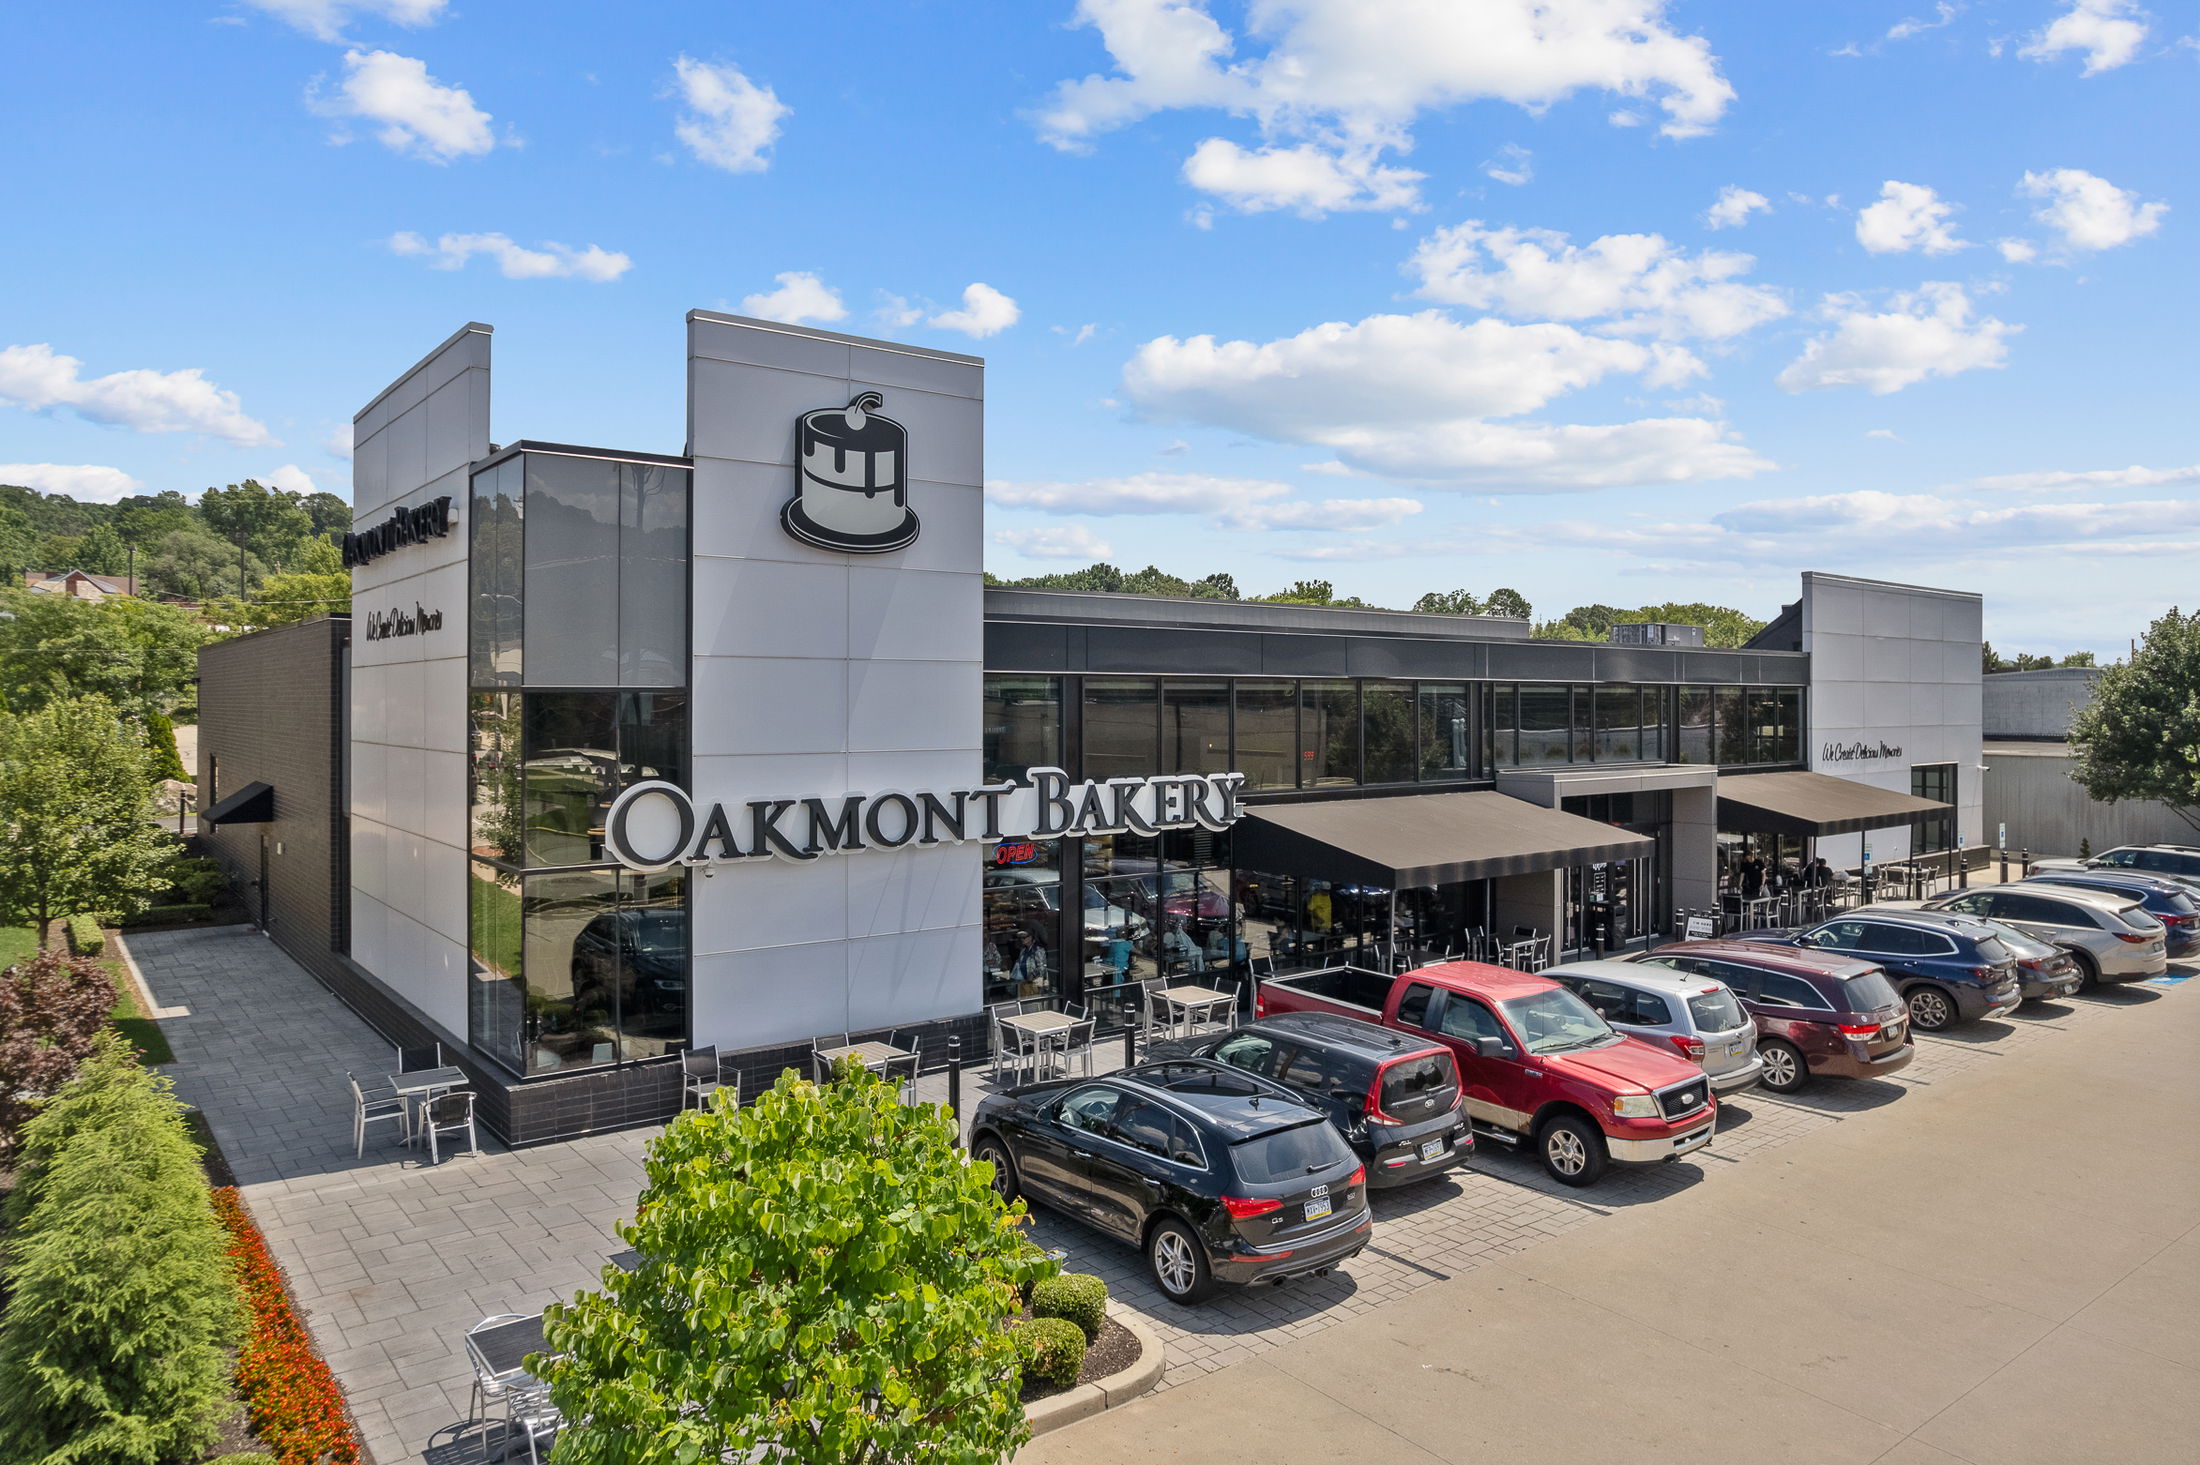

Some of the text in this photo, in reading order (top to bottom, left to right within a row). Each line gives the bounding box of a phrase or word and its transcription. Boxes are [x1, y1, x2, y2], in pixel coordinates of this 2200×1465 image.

[1823, 742, 1834, 761] We
[611, 771, 1245, 867] OAKMONT BAKERY
[996, 843, 1035, 864] OPEN
